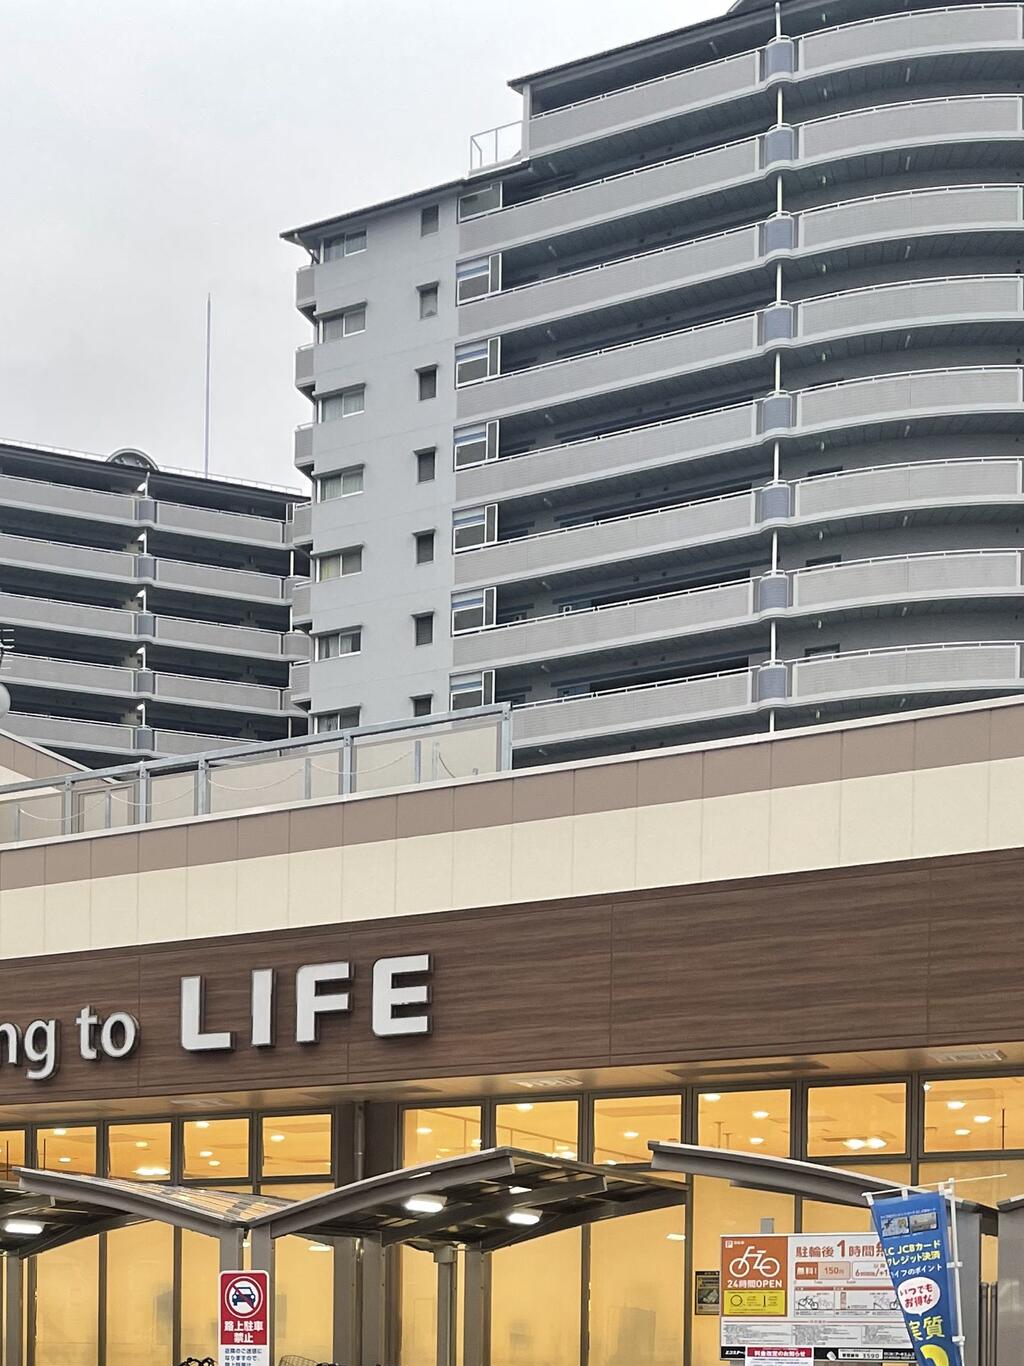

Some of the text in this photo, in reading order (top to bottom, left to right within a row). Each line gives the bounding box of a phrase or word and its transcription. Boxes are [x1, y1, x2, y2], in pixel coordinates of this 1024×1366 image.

[76, 1005, 138, 1060] to
[180, 953, 431, 1052] LIFE
[897, 1240, 941, 1255] JCBカード
[900, 1284, 933, 1296] いつでも
[905, 1295, 933, 1308] お得な
[224, 1320, 264, 1331] 路上駐車
[234, 1333, 254, 1343] 禁止
